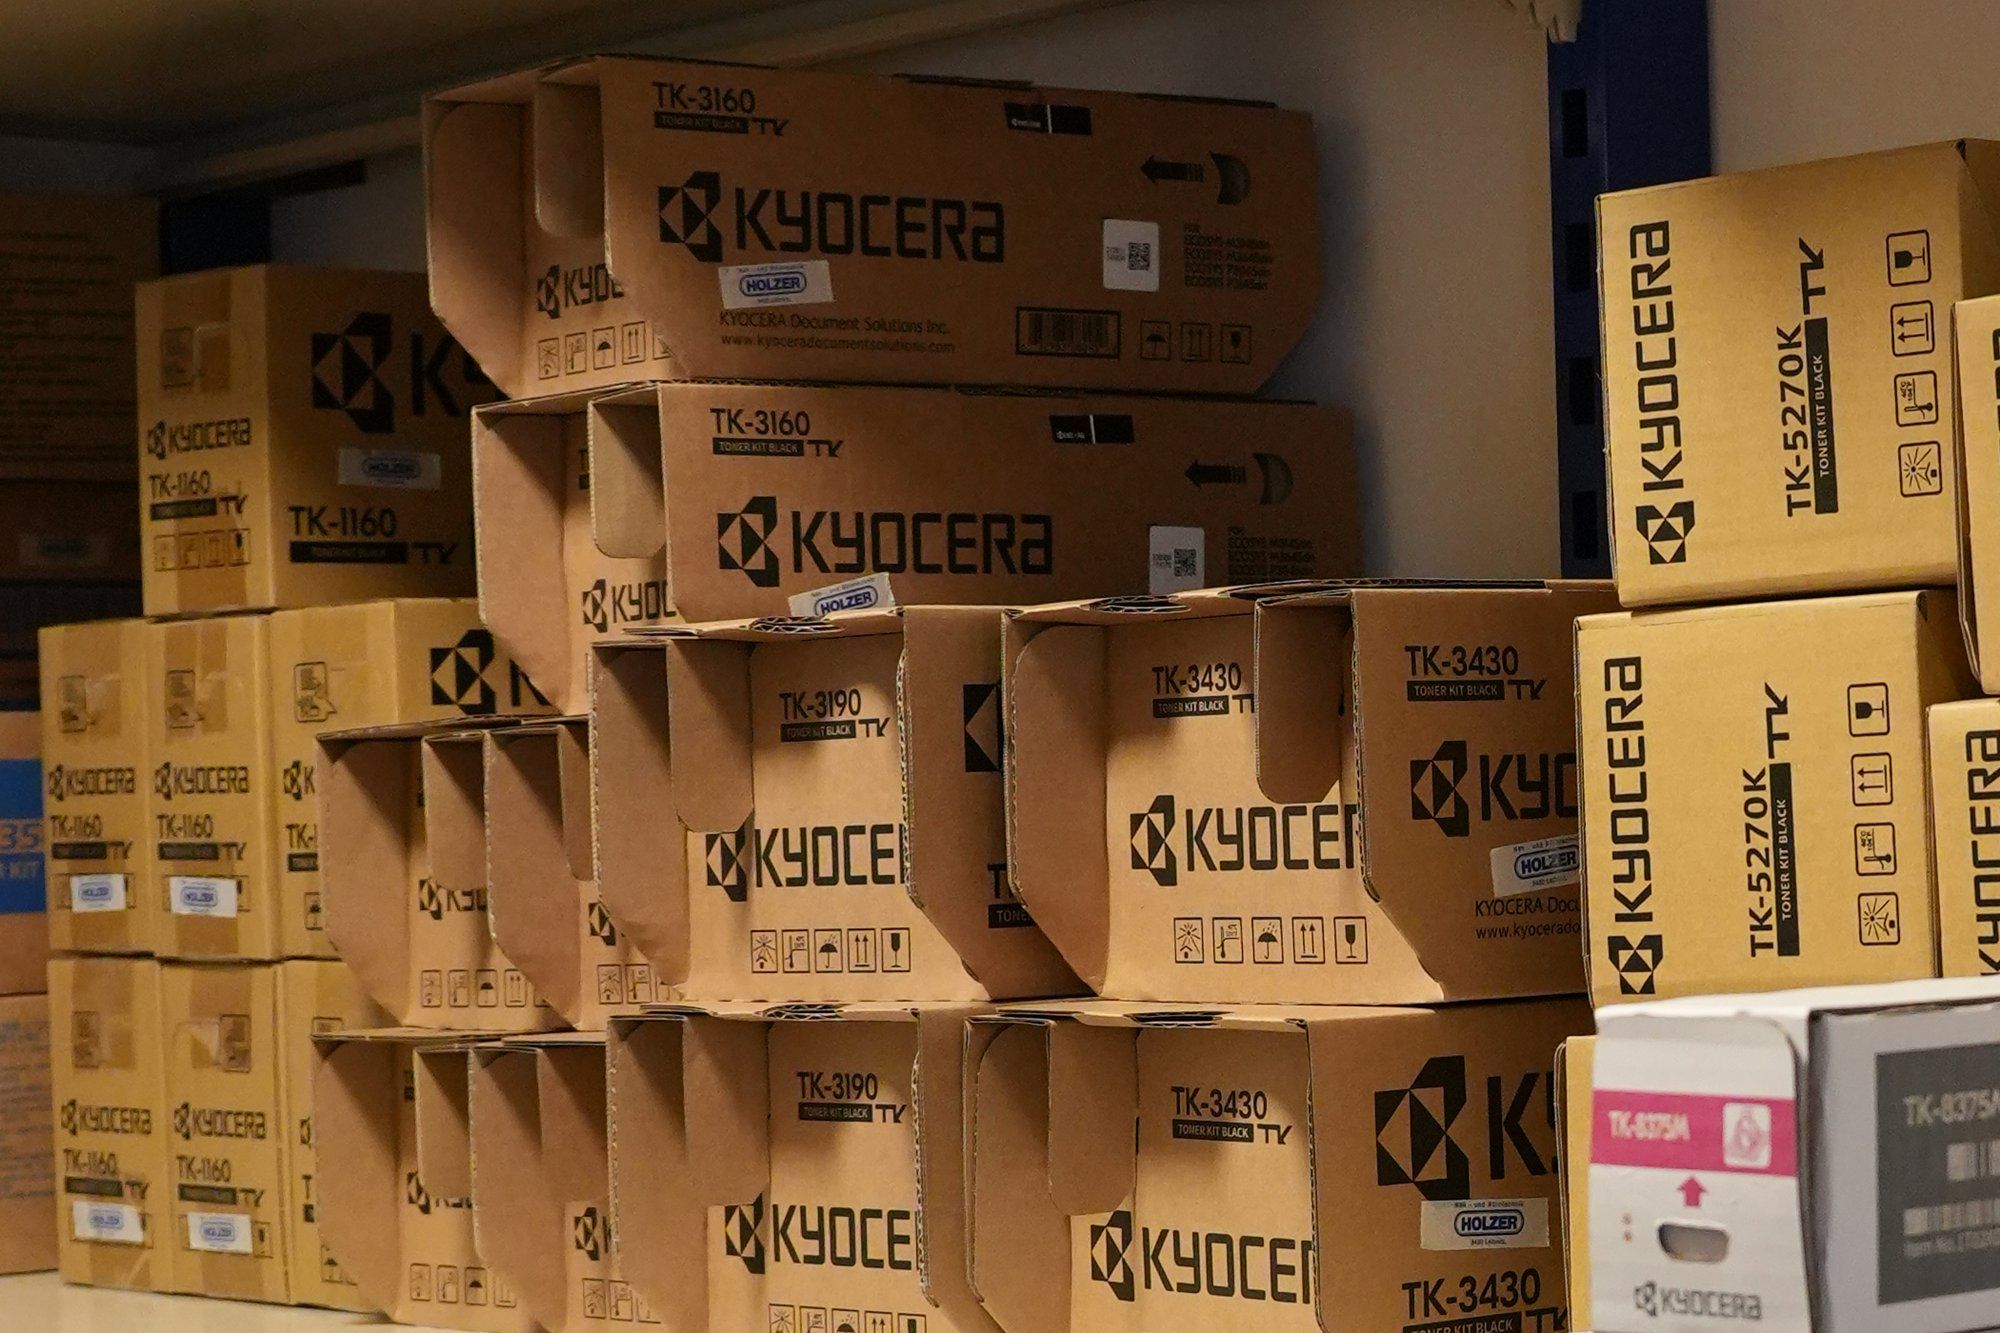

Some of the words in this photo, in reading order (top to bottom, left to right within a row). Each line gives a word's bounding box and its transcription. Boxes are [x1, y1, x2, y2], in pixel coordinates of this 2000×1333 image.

[652, 81, 756, 114] TK-3160
[736, 187, 1004, 263] KYOCERA
[746, 276, 802, 292] HOLZER
[720, 311, 786, 328] KYOCERA
[790, 314, 859, 331] Document
[865, 318, 922, 334] Solutions
[1630, 220, 1684, 491] KYOCERA
[1812, 354, 1825, 400] BLACK
[710, 407, 810, 436] TK-3160
[1776, 322, 1812, 518] TK-5270K
[1816, 404, 1826, 426] KIT
[169, 418, 251, 452] KYOCERA
[769, 441, 799, 454] BLACK
[1817, 429, 1830, 478] TONER
[149, 469, 211, 498] TK-1160
[289, 506, 397, 537] TK-1160
[792, 511, 1053, 575] KYOCERA
[1405, 645, 1519, 676] TK-3430
[1152, 662, 1242, 694] TK-3430
[1413, 684, 1447, 697] TONER
[1449, 684, 1465, 696] KIT
[1467, 683, 1498, 696] BLACK
[779, 688, 862, 720] TK-3190
[1158, 702, 1184, 714] TONER
[1185, 701, 1197, 712] KIT
[1199, 700, 1225, 712] BLACK
[827, 724, 852, 736] BLACK
[65, 767, 136, 795] KYOCERA
[174, 767, 249, 795] KYOCERA
[1605, 656, 1654, 923] KYOCERA
[51, 814, 103, 839] TK-1160
[157, 814, 213, 839] TK-1160
[1776, 799, 1788, 844] BLACK
[1521, 848, 1577, 875] HOLZER
[1742, 767, 1774, 958] TK-5270K
[1779, 847, 1789, 869] KIT
[1476, 898, 1543, 918] KYOCERA
[1780, 872, 1791, 921] TONER
[797, 1072, 878, 1101] TK-3190
[843, 1106, 868, 1118] BLACK
[1171, 1086, 1267, 1119] TK-3430
[79, 1106, 152, 1135] KYOCERA
[193, 1109, 267, 1141] KYOCERA
[1178, 1122, 1205, 1136] TONER
[1206, 1124, 1221, 1137] KIT
[1222, 1125, 1249, 1139] BLACK
[63, 1148, 118, 1175] TK-1160
[176, 1155, 232, 1182] TK-1160
[772, 1204, 918, 1270] KYOCE
[1461, 1216, 1517, 1231] HOLZER
[1402, 1268, 1540, 1319] TK-3430
[1661, 1288, 1761, 1321] KYOCERA
[1475, 1318, 1514, 1333] BLACK
